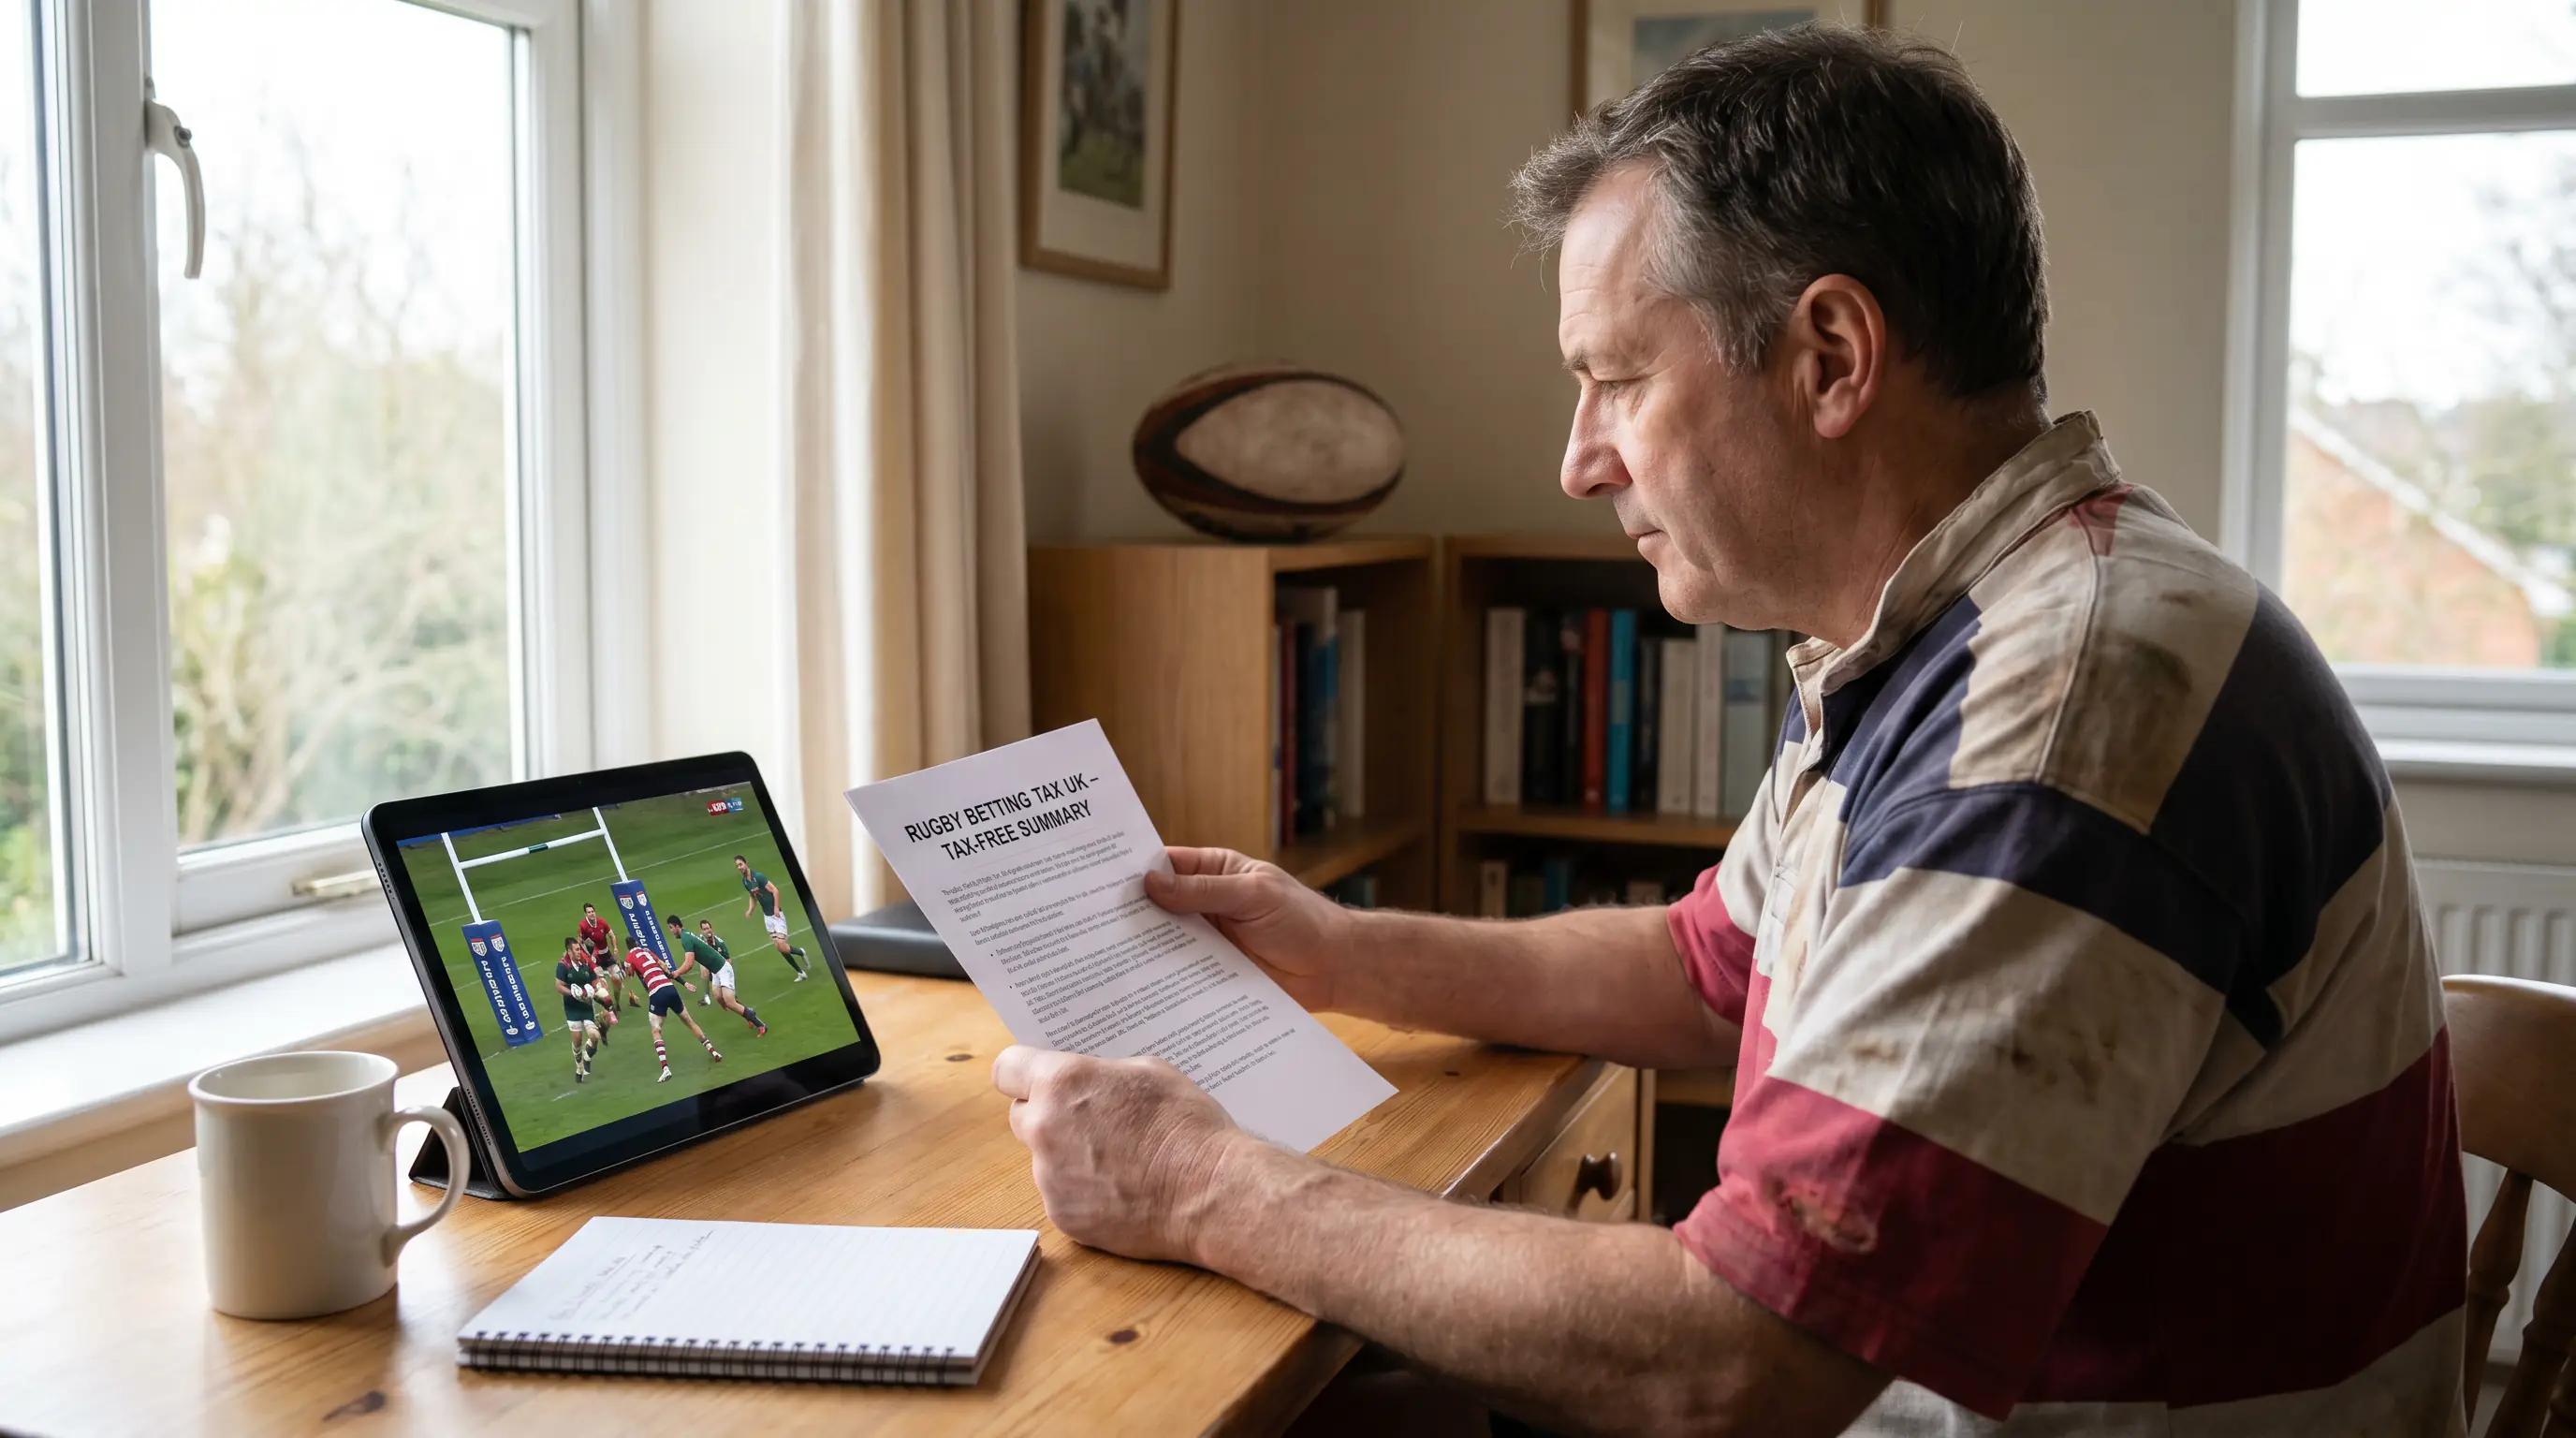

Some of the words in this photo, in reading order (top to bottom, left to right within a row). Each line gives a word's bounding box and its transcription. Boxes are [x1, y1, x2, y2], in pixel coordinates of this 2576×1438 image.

[904, 812, 963, 843] RUGBY
[963, 792, 1032, 826] BETTING
[1031, 781, 1065, 803] TAX
[1062, 773, 1090, 794] UK
[941, 824, 1019, 860] TAX-FREE
[1017, 800, 1092, 837] SUMMARY
